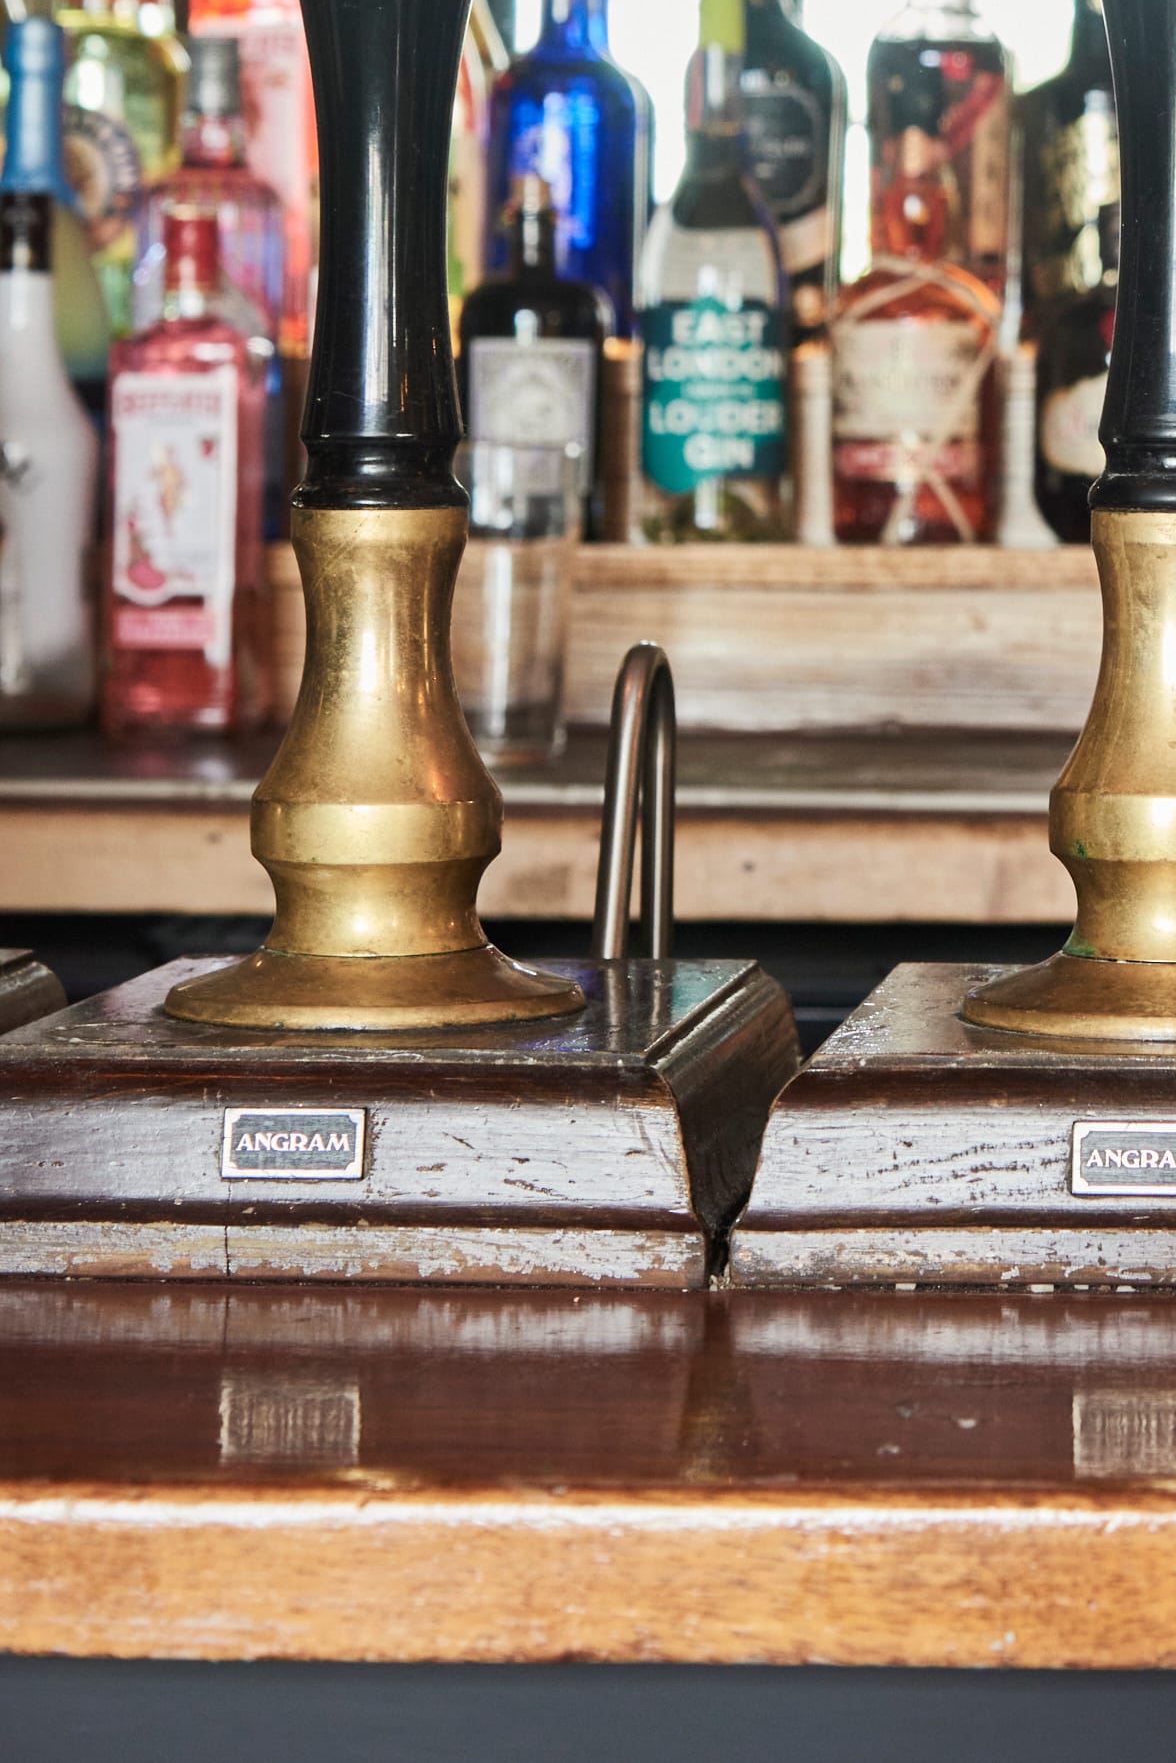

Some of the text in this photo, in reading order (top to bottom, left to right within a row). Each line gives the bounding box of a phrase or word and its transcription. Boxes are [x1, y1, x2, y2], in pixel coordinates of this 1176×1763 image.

[672, 310, 768, 345] EAST
[648, 347, 785, 381] LONDON
[682, 434, 755, 471] GIN
[236, 1132, 350, 1152] ANGRAM
